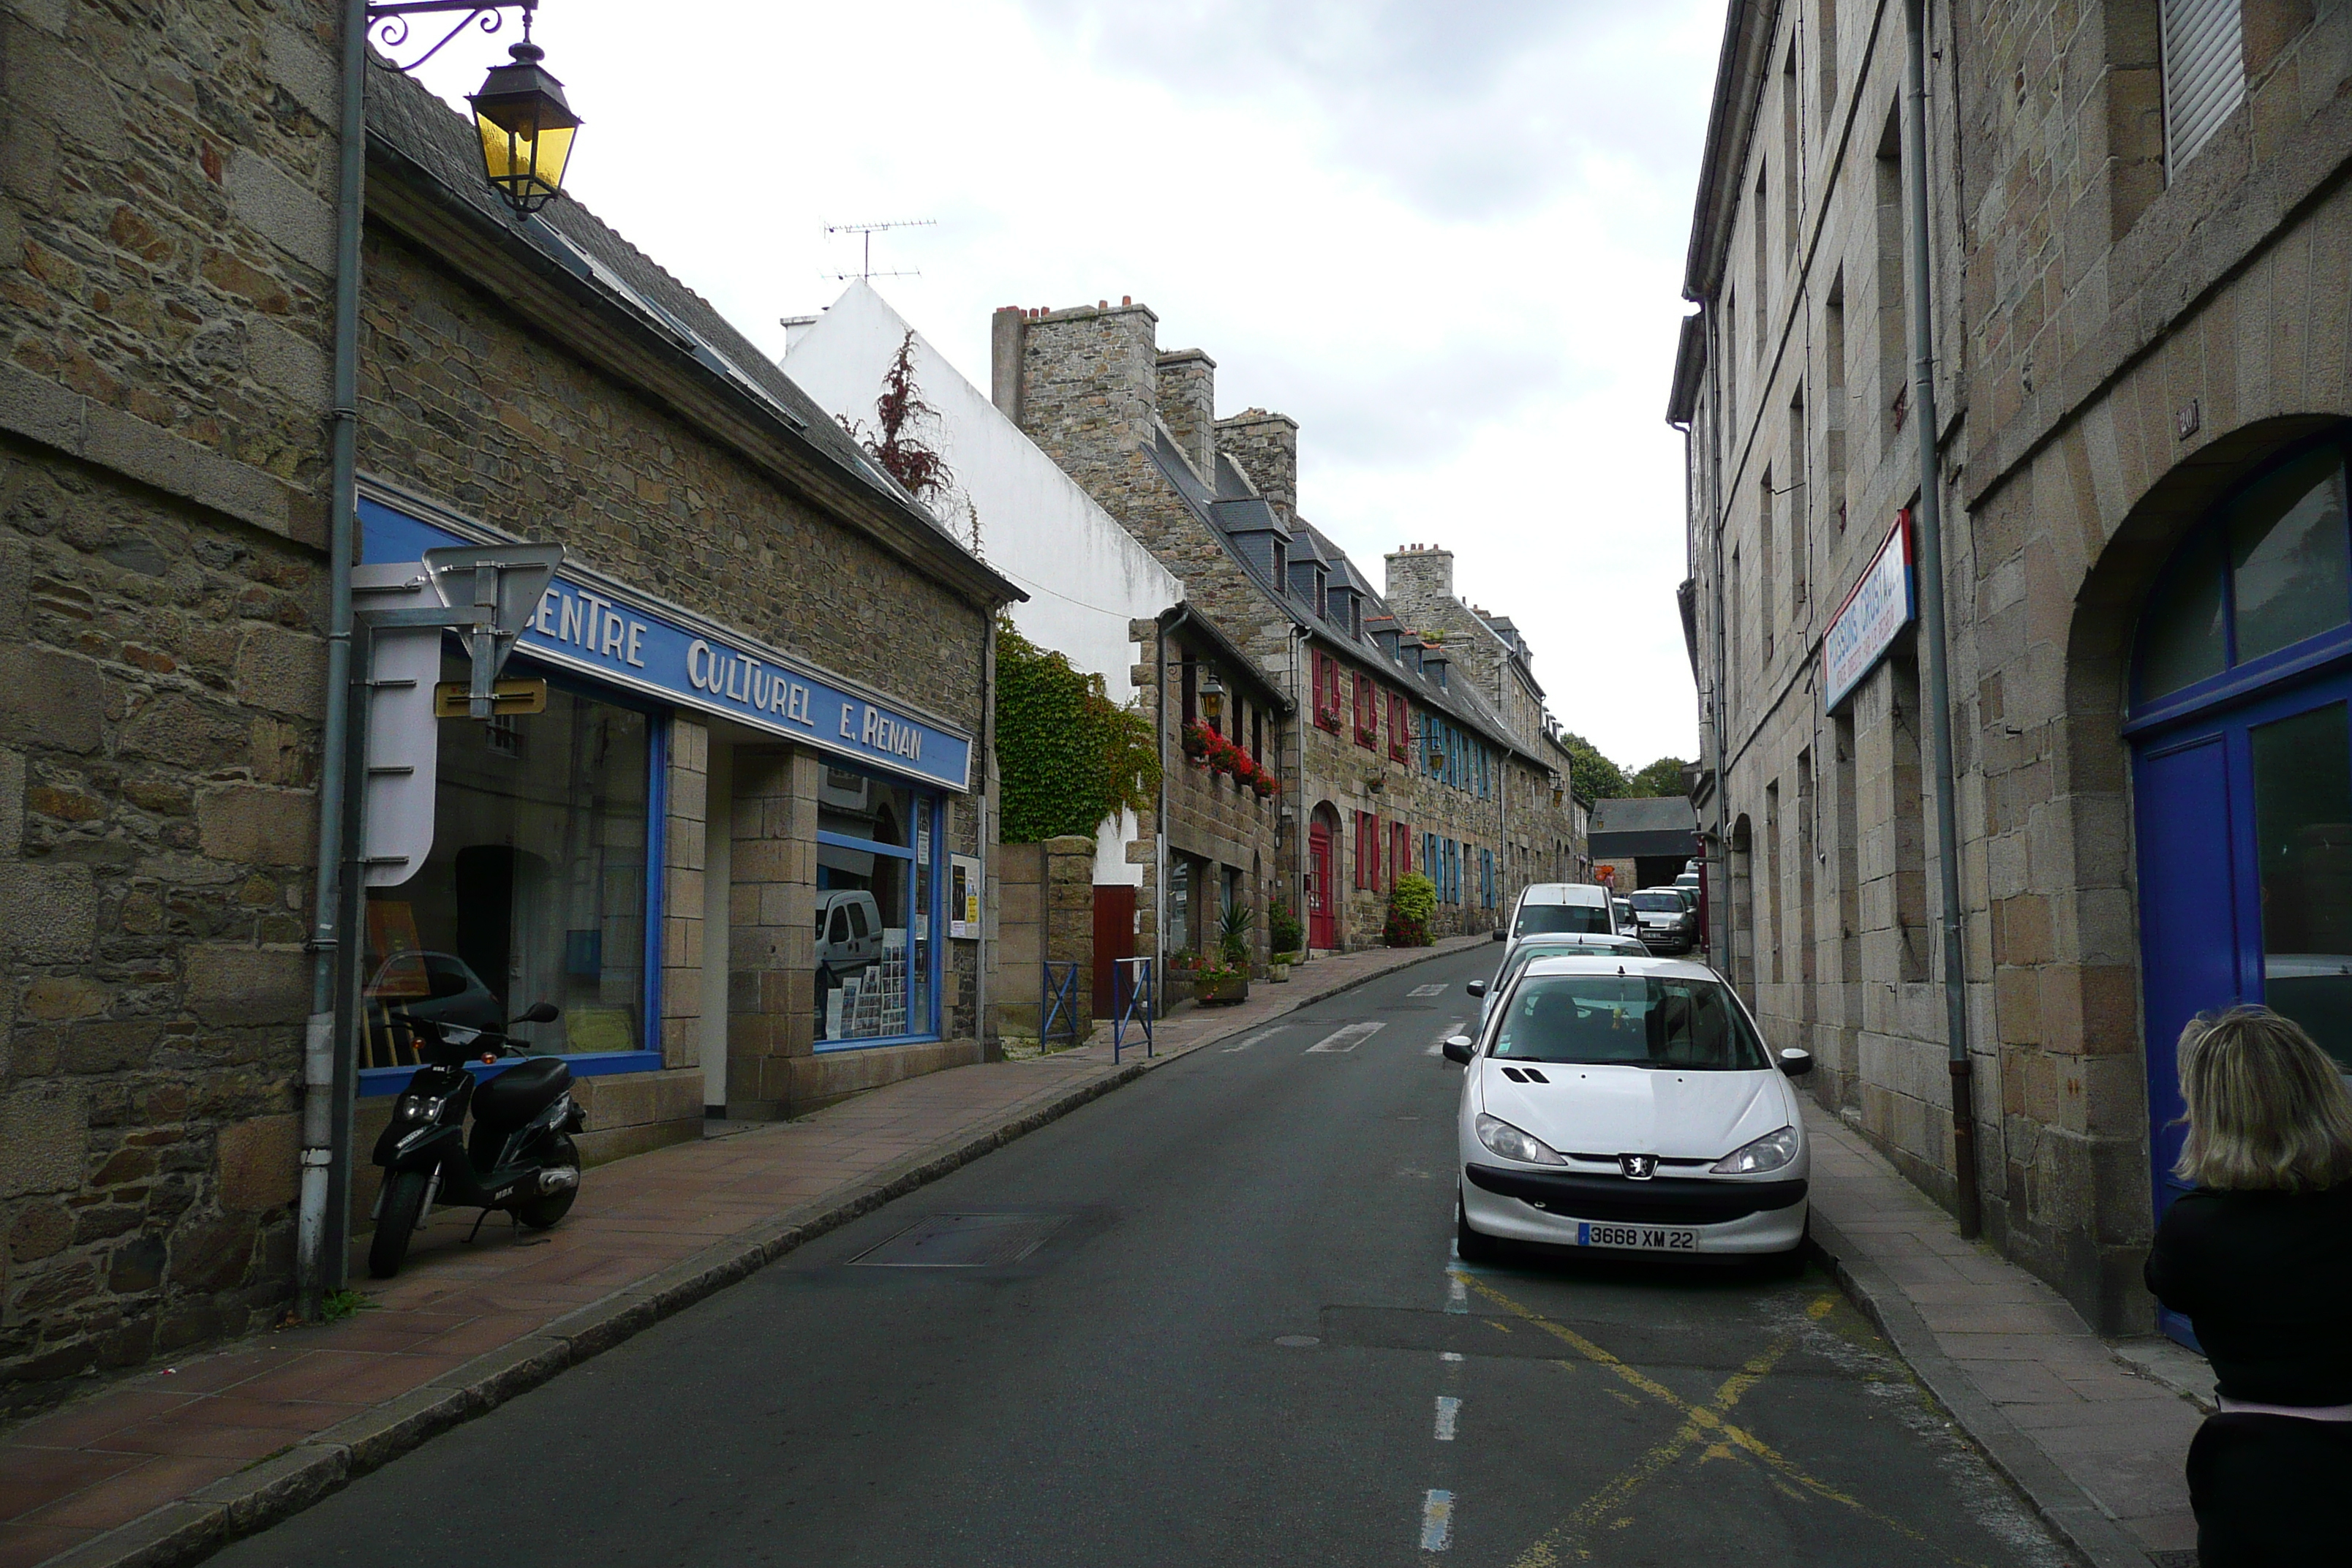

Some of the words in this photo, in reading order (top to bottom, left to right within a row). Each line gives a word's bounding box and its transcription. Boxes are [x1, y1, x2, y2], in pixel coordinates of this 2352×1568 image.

[2179, 408, 2193, 431] 20
[1829, 603, 1858, 673] POISSONS
[525, 587, 647, 668] ENTRE
[687, 639, 814, 726] CULTUREL
[840, 702, 856, 741] E.
[862, 704, 922, 762] RENAN
[1591, 1227, 1637, 1245] 3668
[1642, 1229, 1665, 1248] XM
[1670, 1232, 1693, 1248] 22
